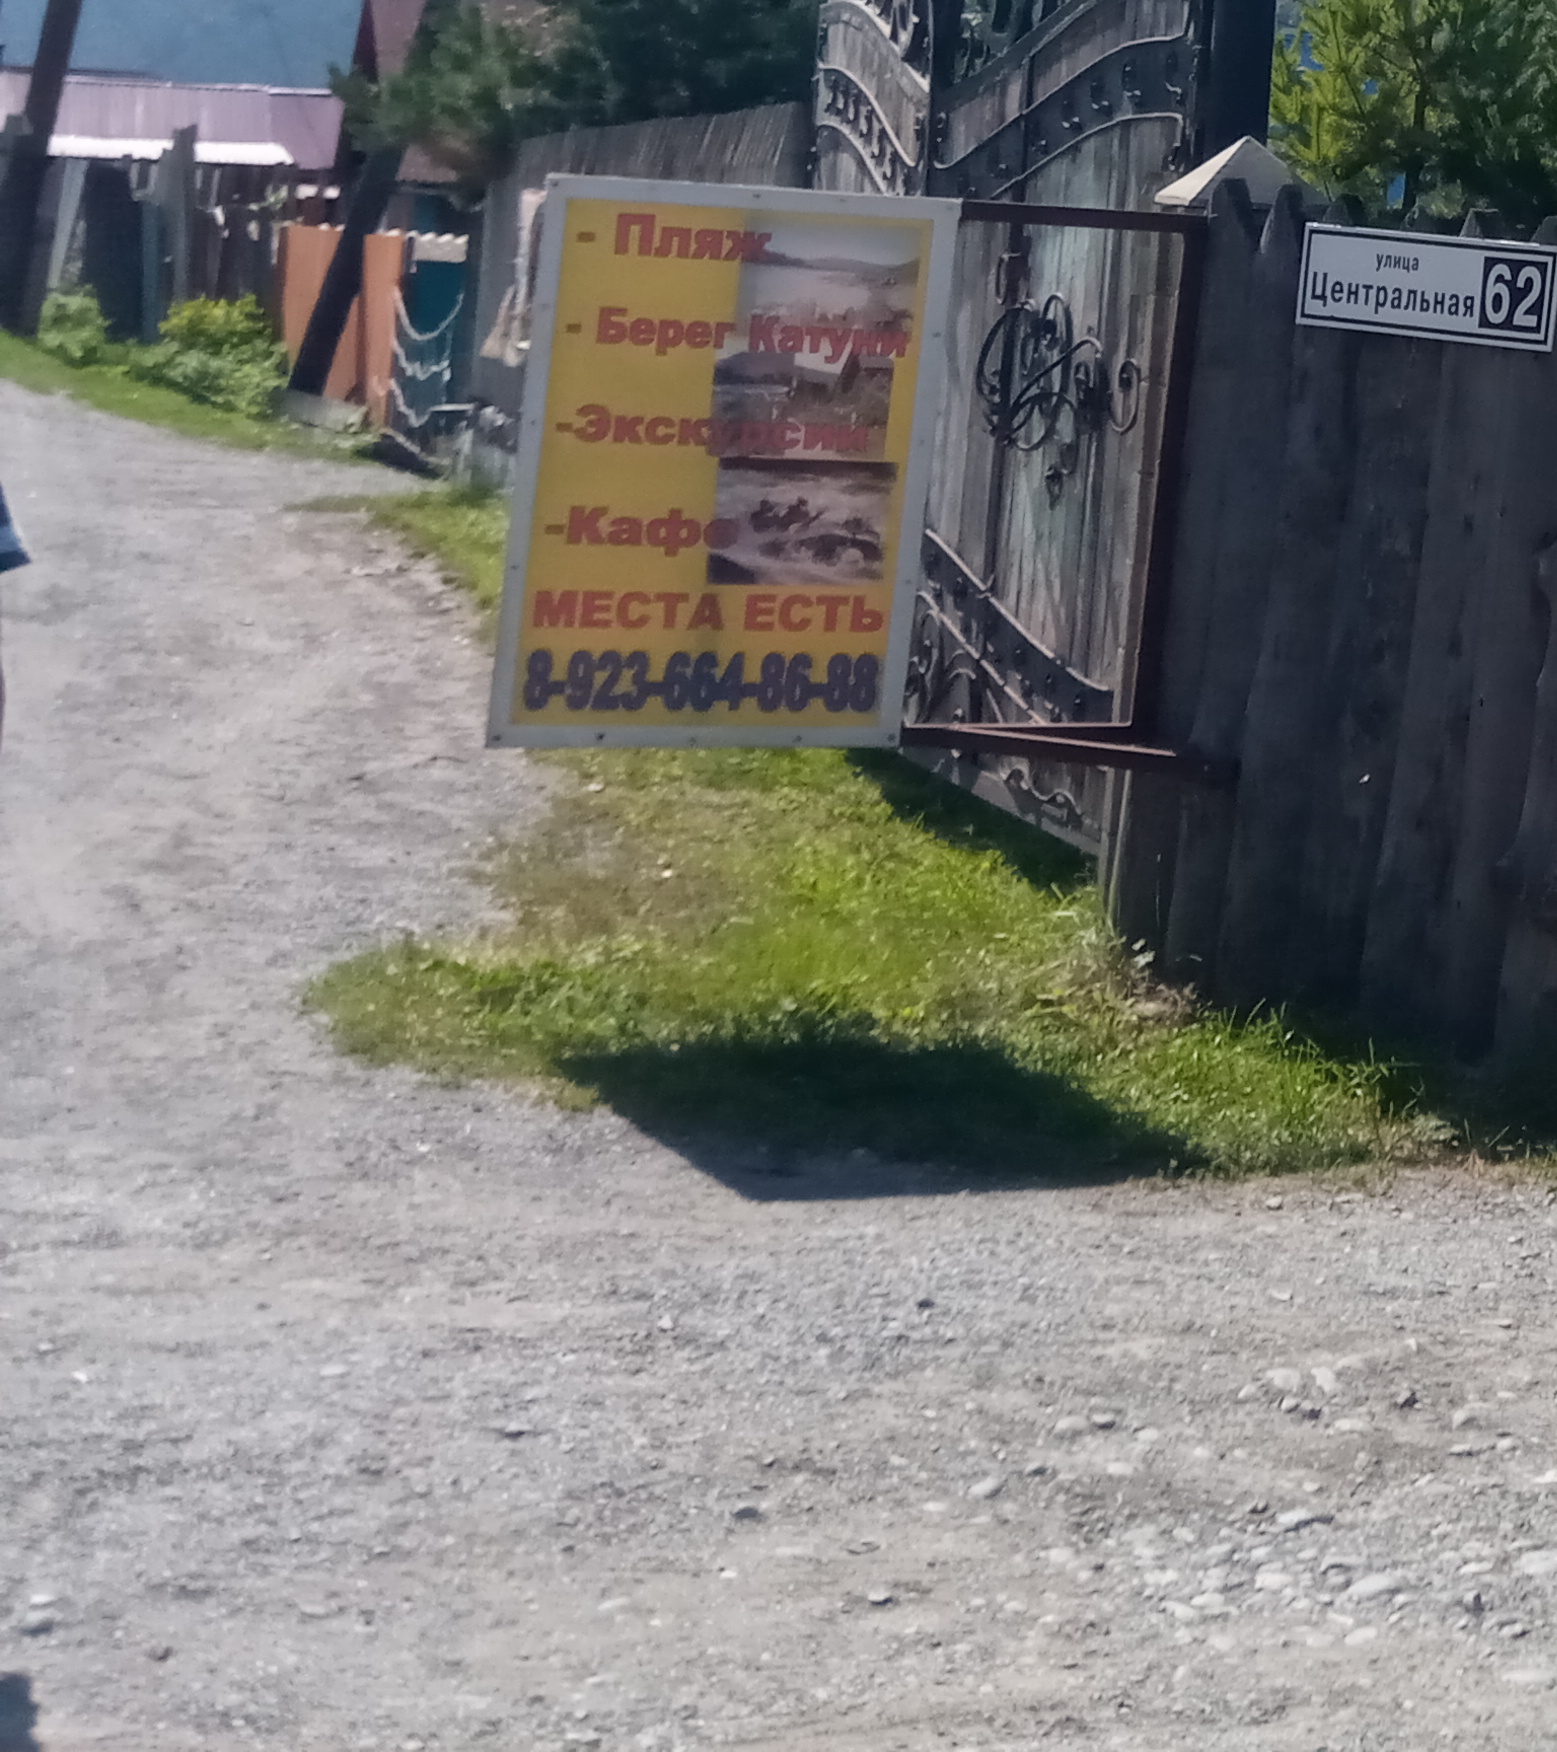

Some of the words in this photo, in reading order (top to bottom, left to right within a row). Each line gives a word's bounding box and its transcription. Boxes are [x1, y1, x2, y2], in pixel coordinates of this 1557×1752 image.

[614, 213, 772, 264] Пляж
[1375, 253, 1420, 271] улица
[1309, 271, 1475, 319] Центральная
[1484, 263, 1543, 327] 62
[596, 307, 737, 356] Берег
[748, 314, 913, 364] Катуни
[533, 590, 724, 630] МЕСТА
[743, 593, 885, 633] ЕСТЬ
[525, 649, 880, 712] 8-923-664-86-88
